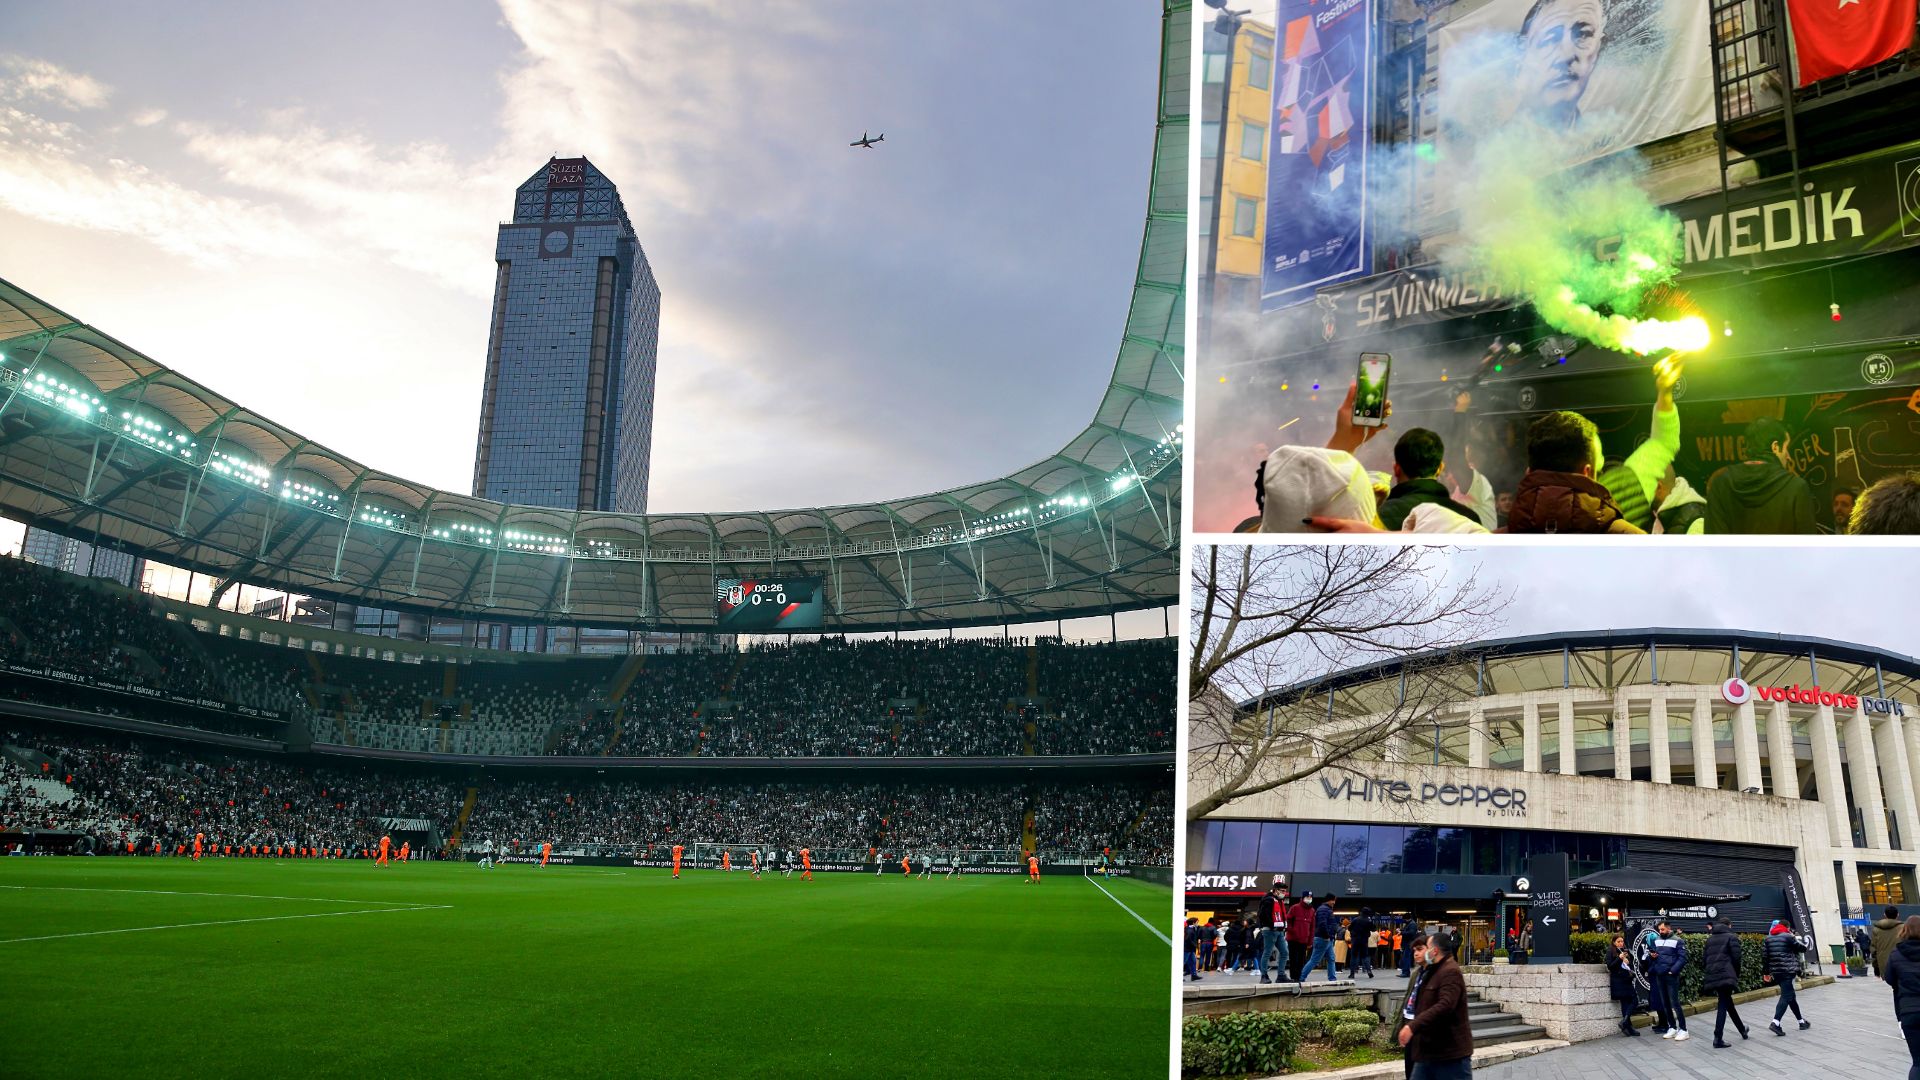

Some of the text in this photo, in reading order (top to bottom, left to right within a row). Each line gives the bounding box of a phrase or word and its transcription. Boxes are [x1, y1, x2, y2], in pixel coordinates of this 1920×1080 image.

[550, 163, 583, 174] SÜZER
[548, 174, 583, 184] PLAZA
[754, 584, 783, 593] 00:26
[751, 593, 762, 605] 0
[776, 593, 787, 604] 0
[1757, 683, 1905, 716] vodafone park
[1487, 809, 1497, 817] by
[1240, 875, 1258, 890] JK
